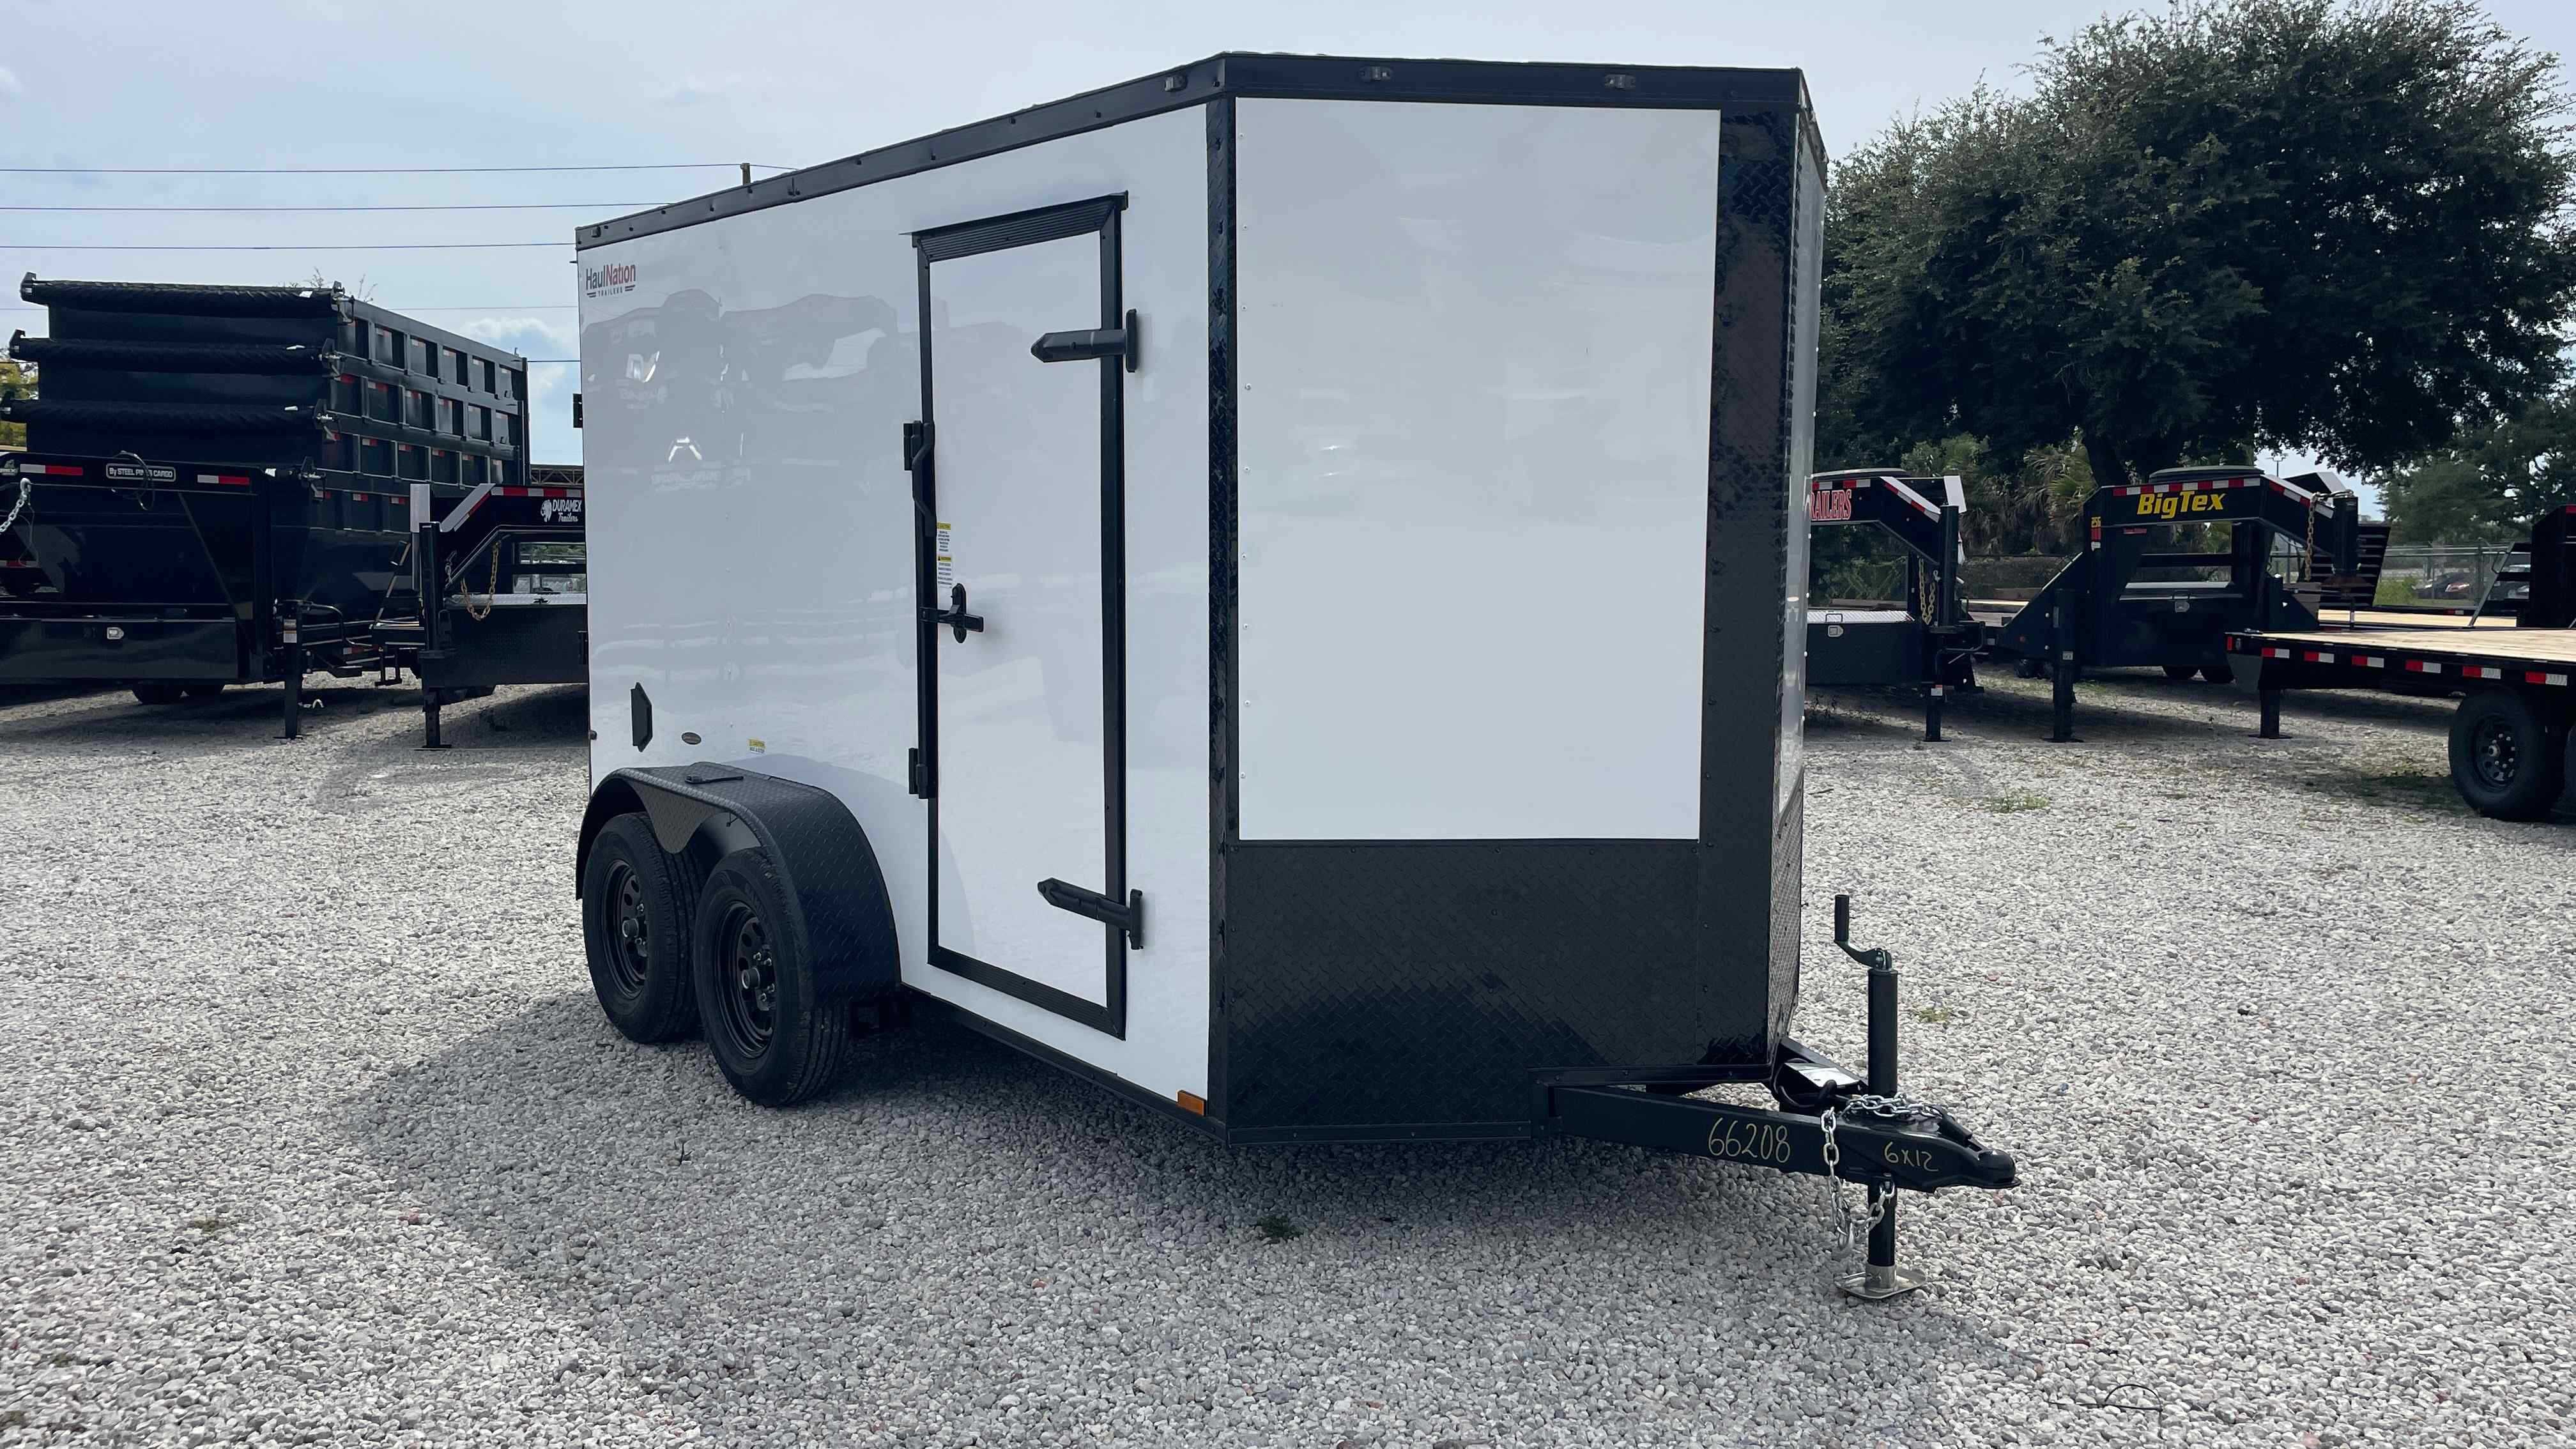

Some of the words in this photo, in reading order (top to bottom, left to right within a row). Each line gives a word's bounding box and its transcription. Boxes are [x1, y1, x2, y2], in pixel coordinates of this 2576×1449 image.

[586, 263, 636, 290] HaulNation
[109, 468, 117, 476] By
[553, 499, 582, 512] DURAMEX
[2137, 491, 2226, 519] BigTex
[1708, 1117, 1790, 1163] 66208
